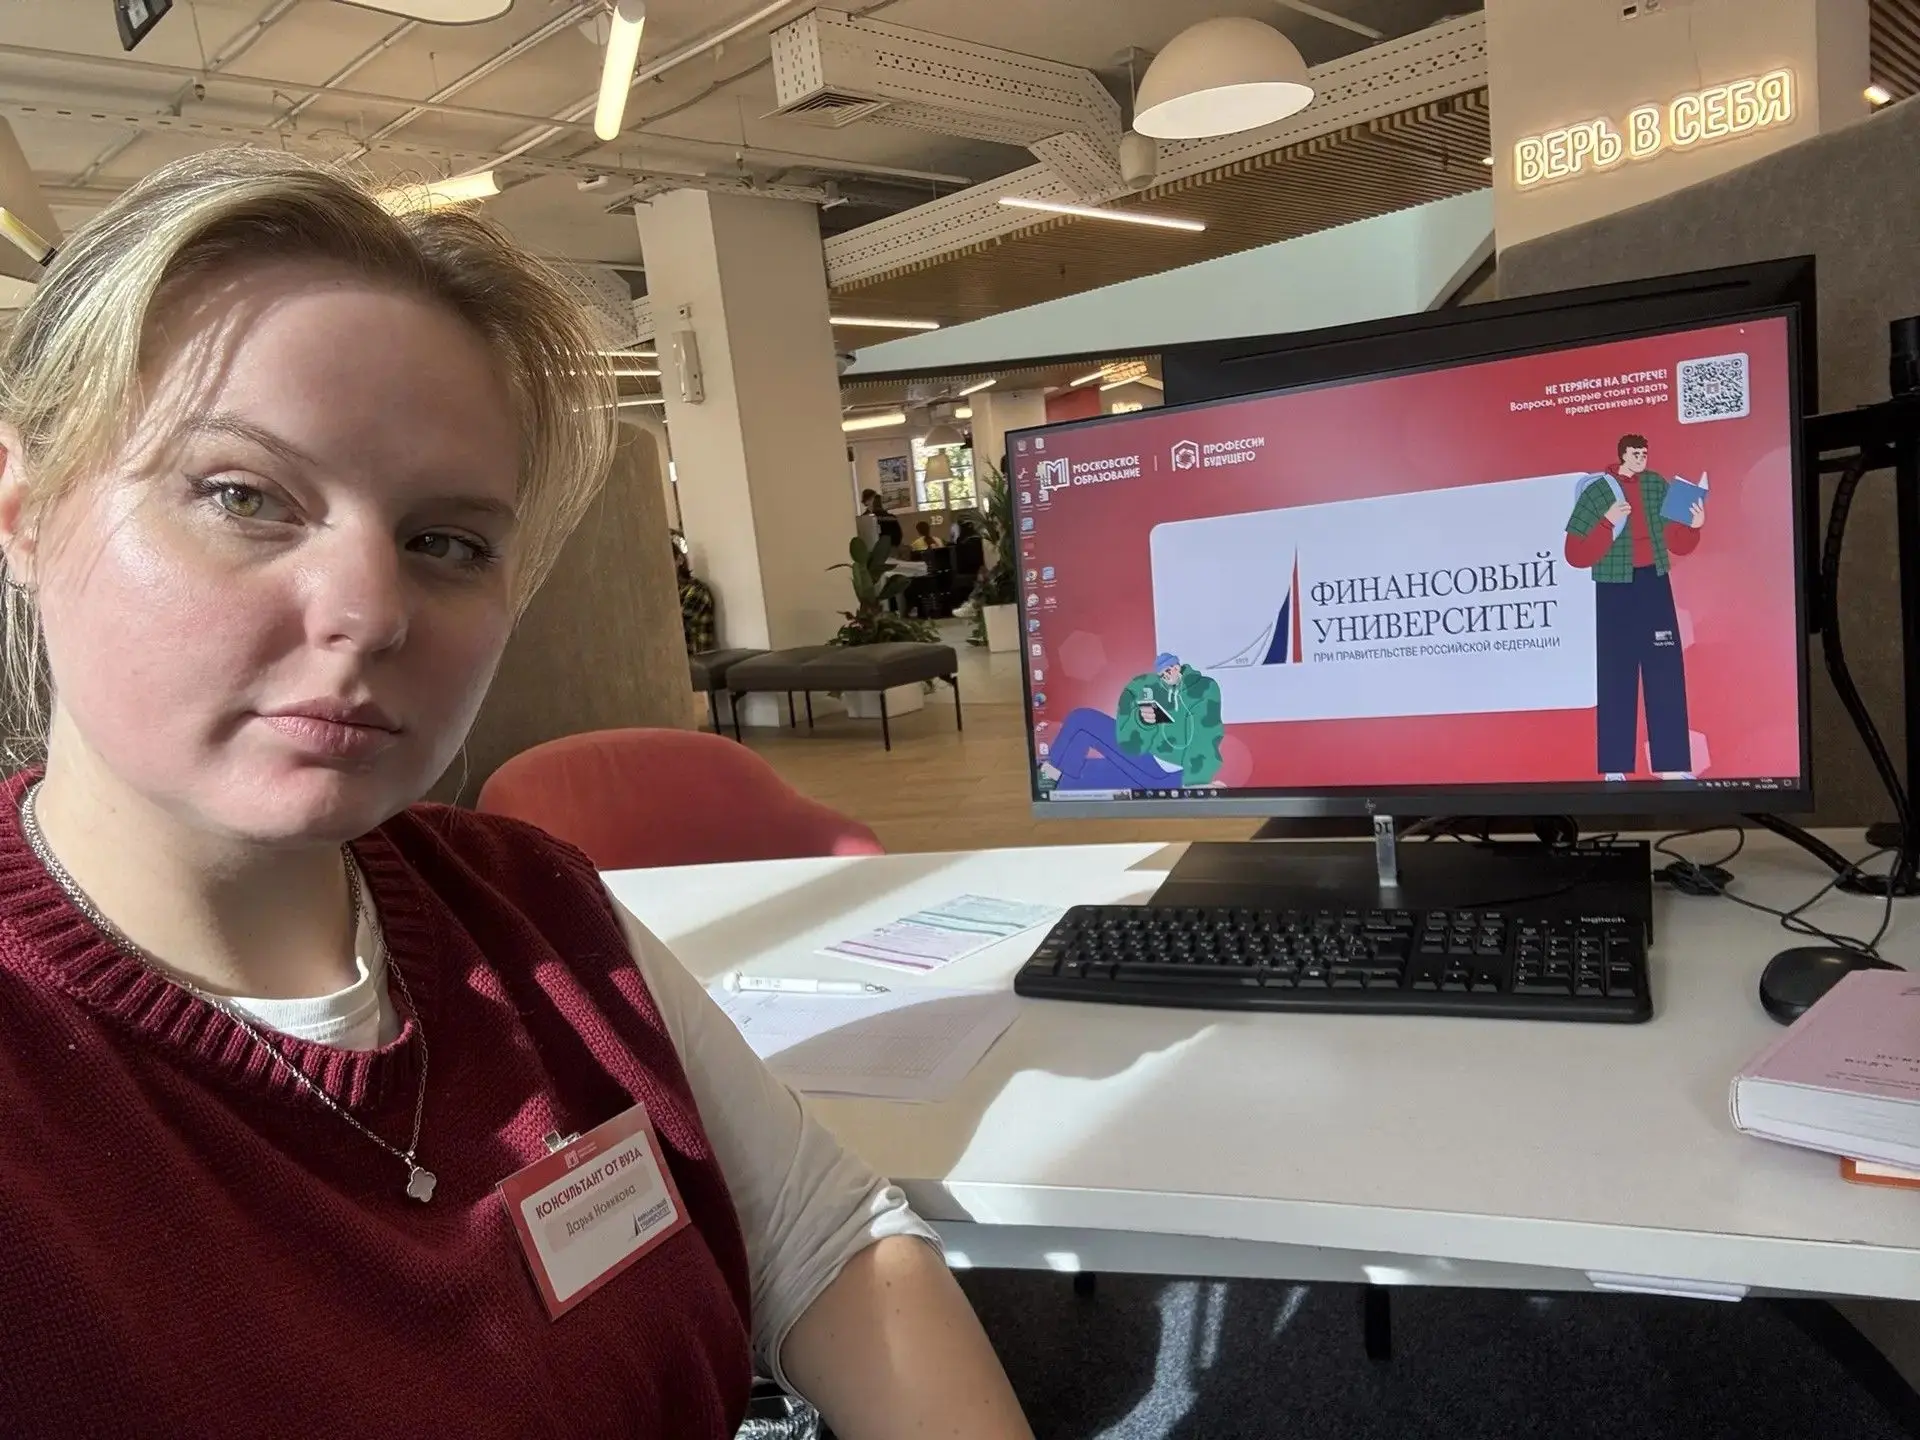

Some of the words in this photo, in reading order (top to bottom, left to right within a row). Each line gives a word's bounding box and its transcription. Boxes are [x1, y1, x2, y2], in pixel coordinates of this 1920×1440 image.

[1515, 119, 1622, 186] ВЕРЬ
[1628, 105, 1661, 157] В
[1669, 70, 1792, 146] СЕБЯ
[1545, 384, 1558, 395] НЕ
[1559, 378, 1602, 393] ТЕРЯЙСЯ
[1603, 376, 1620, 387] НА
[1621, 368, 1667, 384] ВСТРЕЧЕ!
[1510, 398, 1556, 411] Вопросы,
[1557, 391, 1601, 405] которые
[1603, 387, 1631, 398] стоит
[1632, 382, 1669, 395] задать
[1565, 396, 1643, 416] представителю
[1645, 393, 1668, 406] вуза
[1203, 437, 1265, 455] ПРОФЕССИИ
[1203, 450, 1256, 467] БУДУЩЕГО
[1072, 455, 1140, 475] МОСКОВСКОЕ
[1073, 467, 1141, 486] ОБРАЗОВАНИЕ
[1310, 550, 1558, 607] ФИНАНСОВЫЙ
[1311, 600, 1558, 643] УНИВЕРСИТЕТ
[1314, 652, 1334, 662] ПРИ
[1336, 646, 1418, 662] ПРАВИТЕЛЬСТВЕ
[1420, 640, 1491, 656] РОССИЙСКОЙ
[1493, 636, 1560, 652] ФЕДЕРАЦИИ
[535, 1167, 605, 1220] КОНСУЛЬТАНТ
[605, 1159, 620, 1177] ОТ
[620, 1147, 643, 1170] ВУЗА
[566, 1211, 595, 1237] Дарья
[593, 1183, 637, 1218] Новикова
